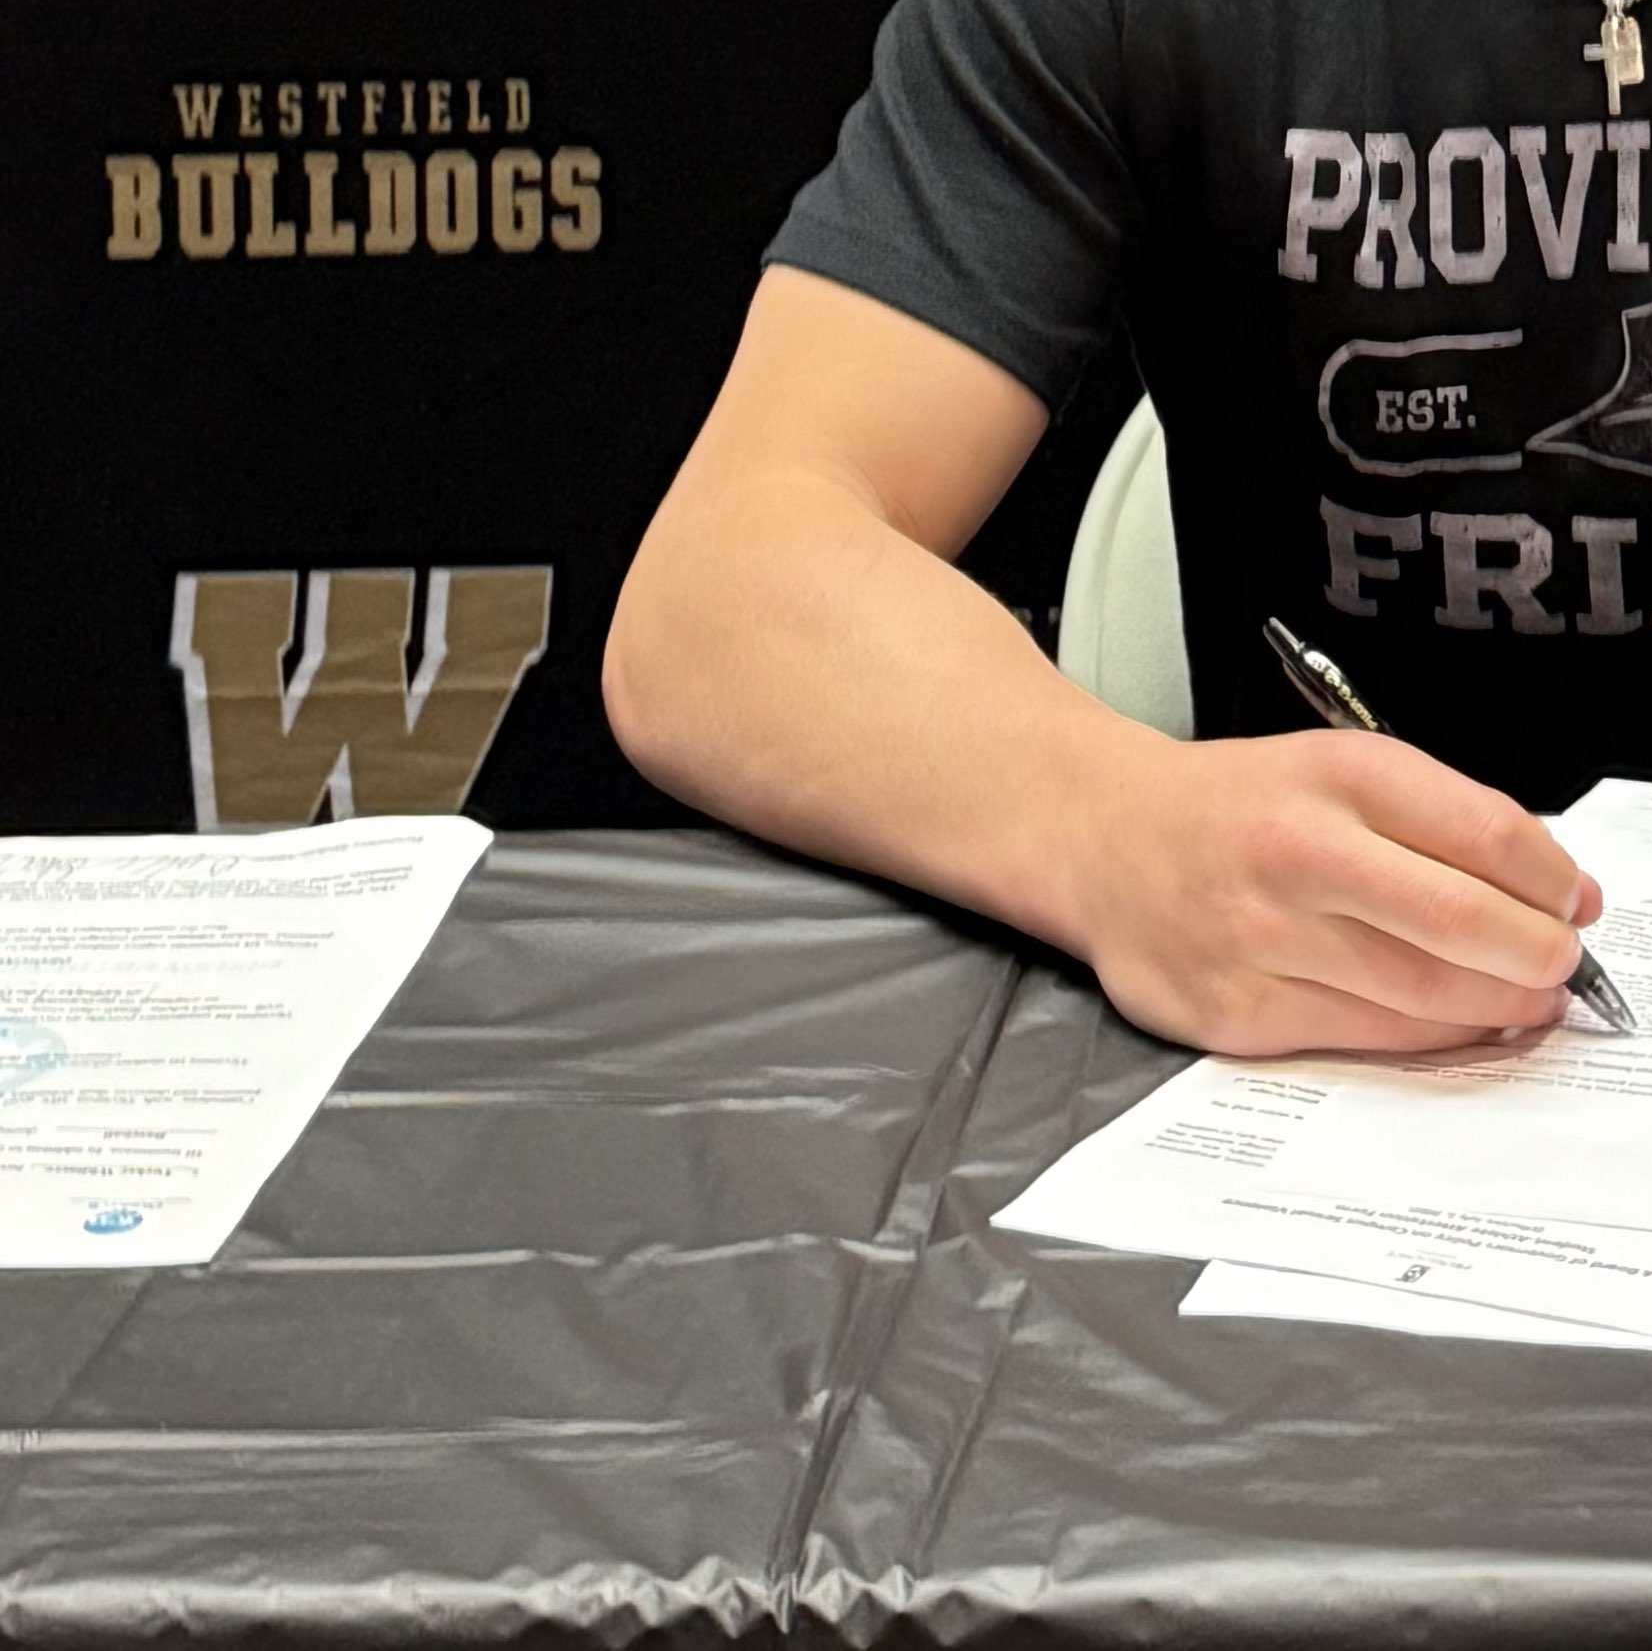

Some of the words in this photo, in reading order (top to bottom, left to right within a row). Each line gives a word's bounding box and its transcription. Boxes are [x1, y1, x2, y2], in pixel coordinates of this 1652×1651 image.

[173, 78, 532, 139] WESTFIELD
[105, 147, 603, 260] BULLDOGS
[1375, 385, 1477, 433] EST.
[170, 567, 553, 832] W
